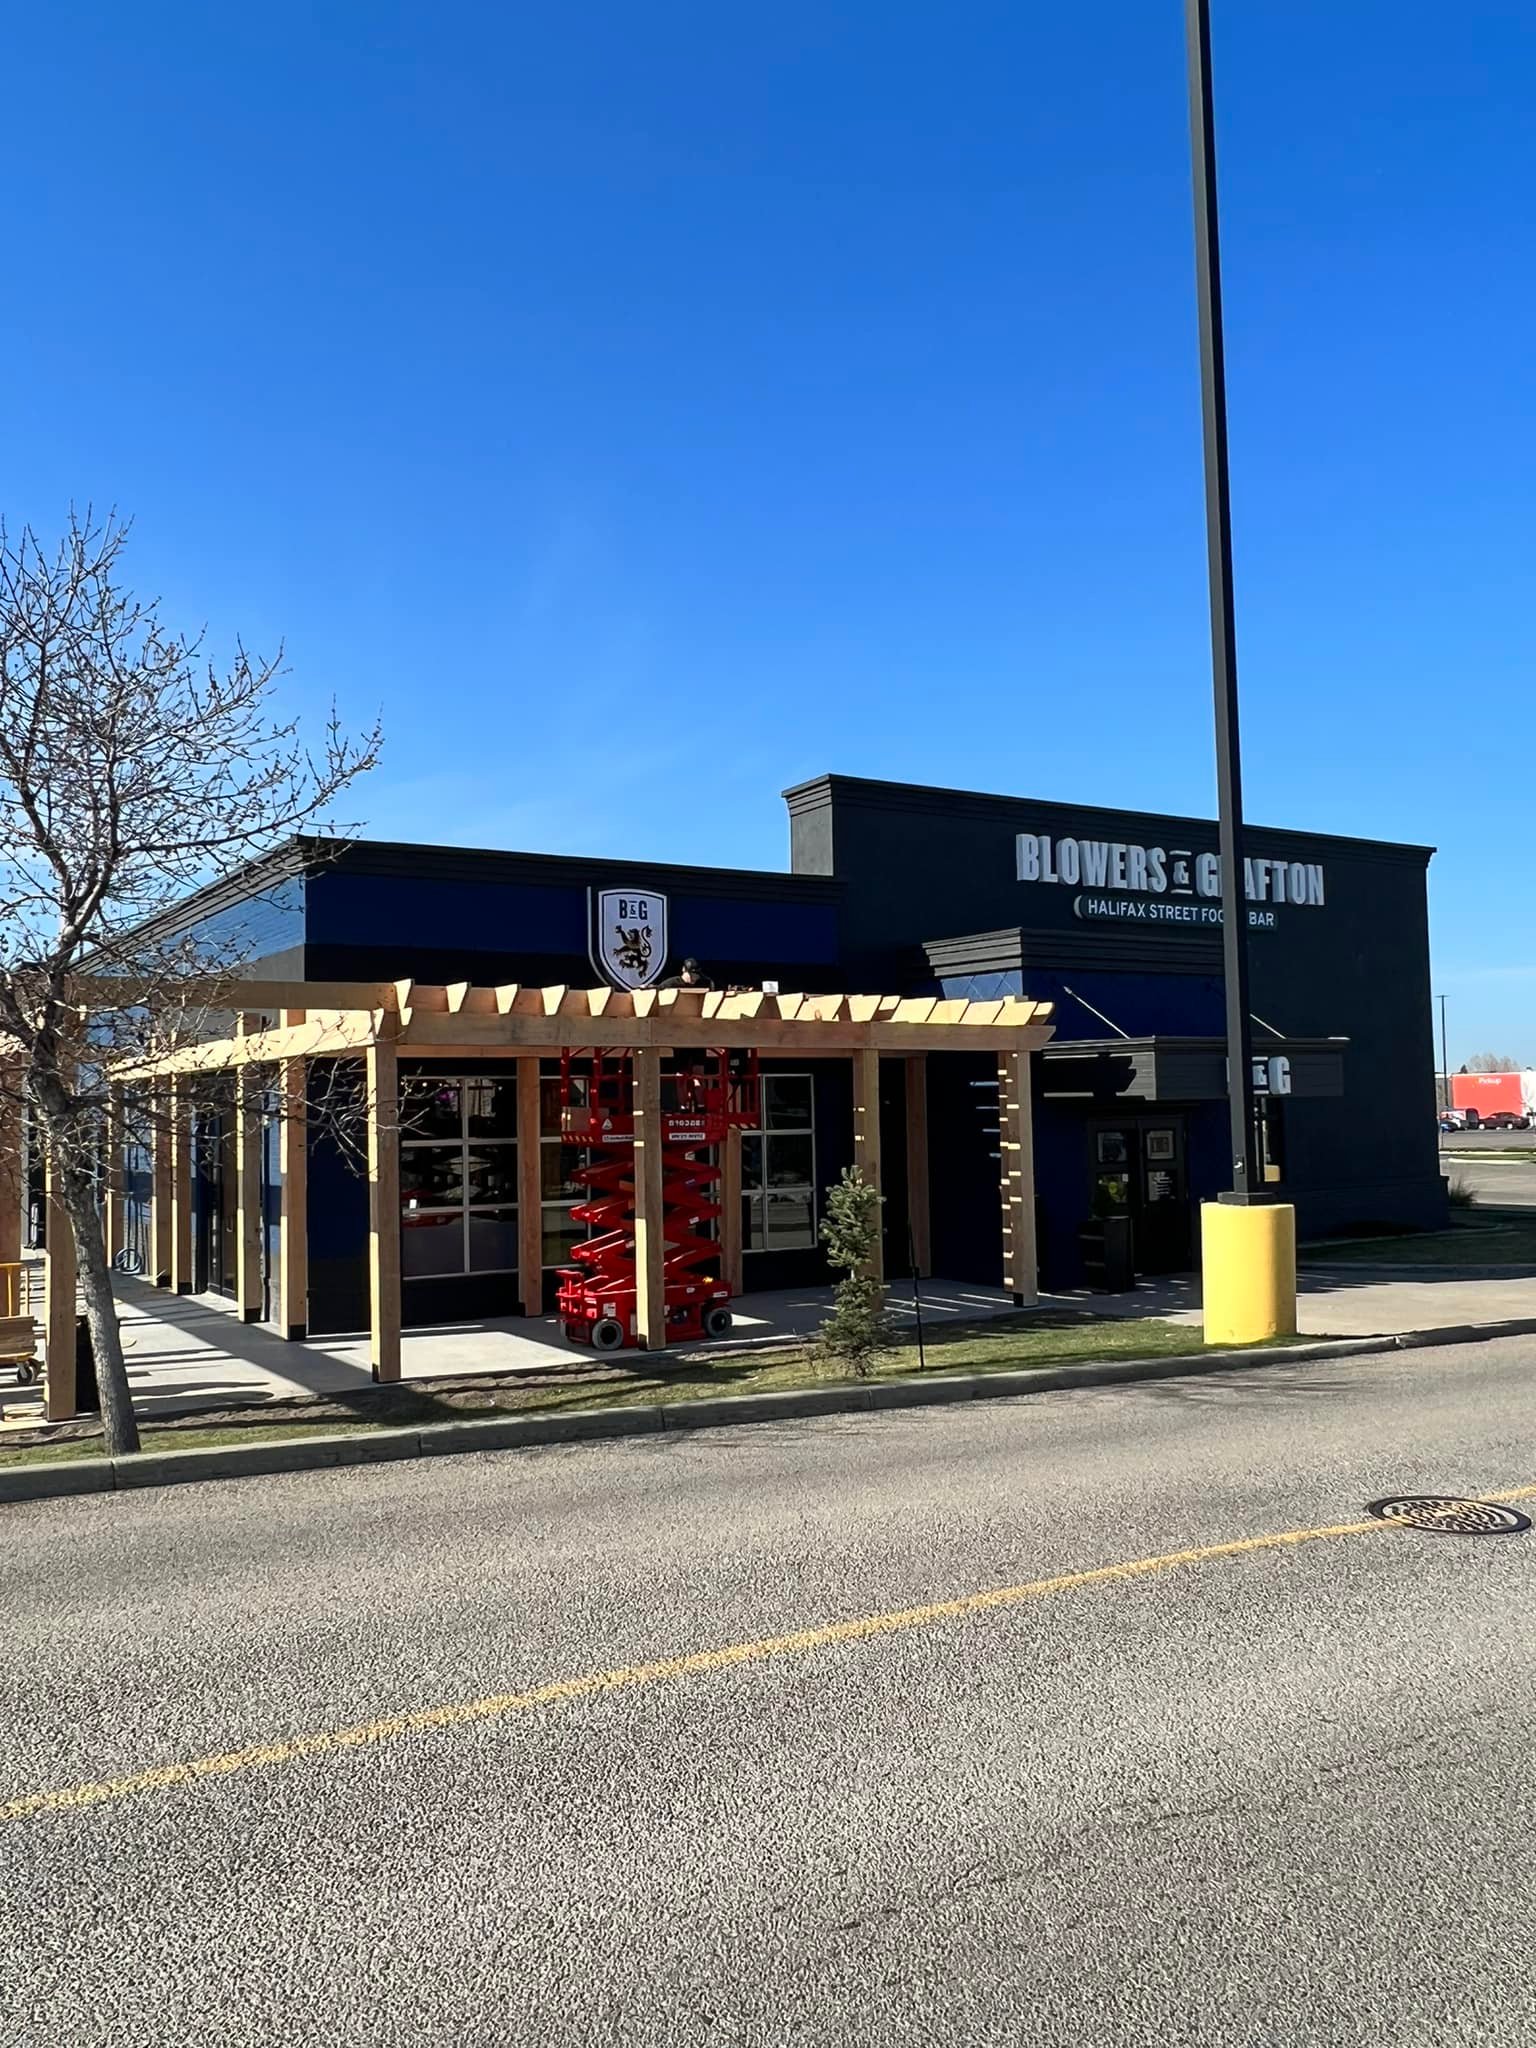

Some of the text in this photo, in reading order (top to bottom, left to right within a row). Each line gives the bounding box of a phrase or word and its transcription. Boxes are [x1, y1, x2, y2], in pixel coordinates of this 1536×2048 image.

[1016, 833, 1325, 906] BLOWERS & GAFTON
[1088, 899, 1146, 918] HALIFAX
[1149, 904, 1198, 921] STREET
[1248, 911, 1274, 926] BAR
